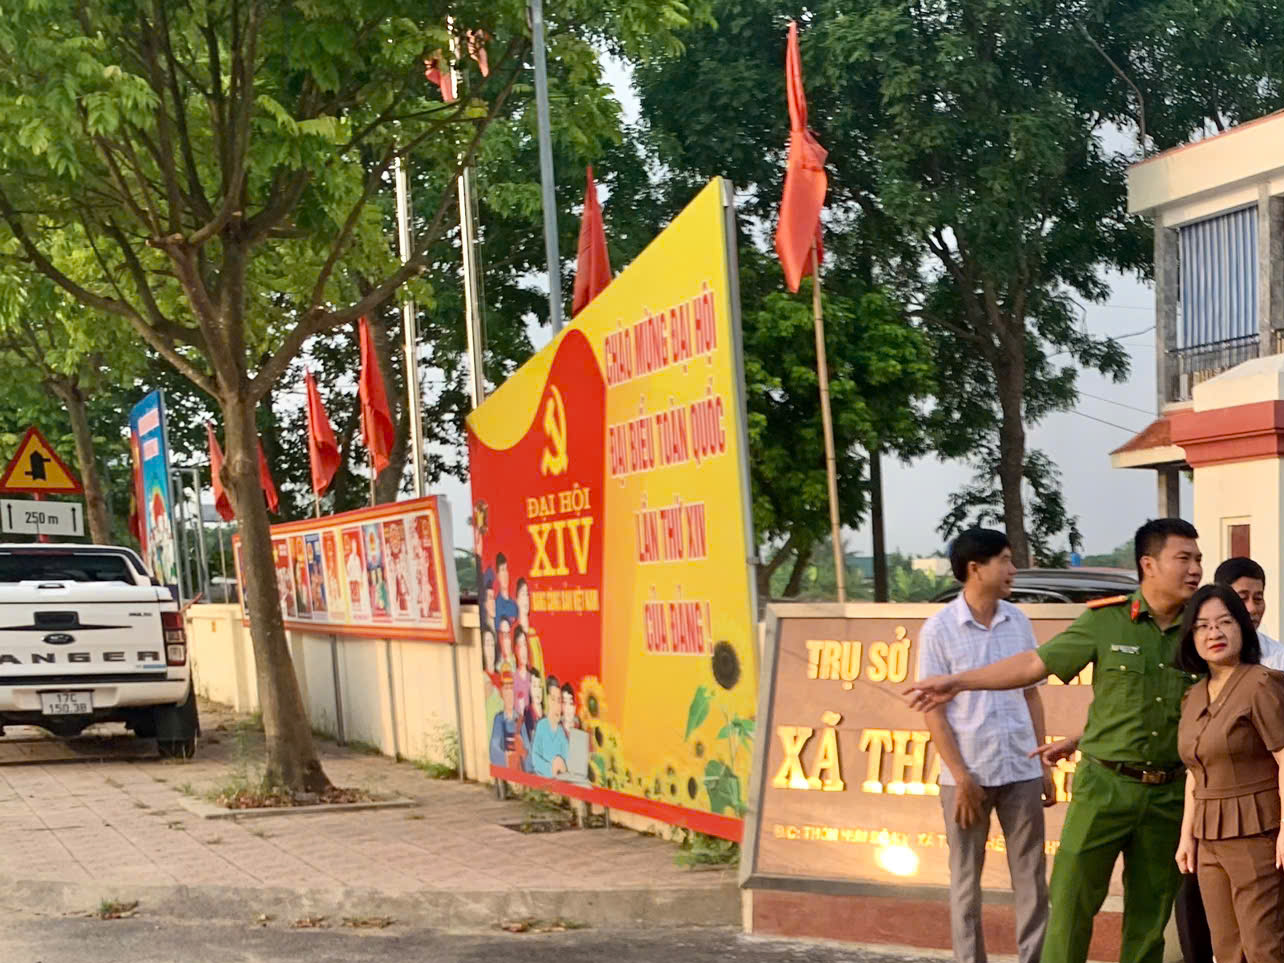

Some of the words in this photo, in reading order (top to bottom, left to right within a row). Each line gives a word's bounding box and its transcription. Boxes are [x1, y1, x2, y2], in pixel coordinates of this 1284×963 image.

[605, 318, 633, 388] CHÀO
[634, 306, 670, 378] MỪNG
[670, 303, 693, 375] ĐẠI
[693, 281, 718, 365] HỘI
[608, 423, 629, 488] ĐẠI
[629, 393, 655, 472] BIỂU
[655, 396, 690, 467] TOÀN
[690, 375, 726, 468] QUỐC
[25, 511, 46, 525] 250
[47, 514, 59, 525] m
[526, 493, 556, 521] ĐẠI
[558, 482, 592, 517] HỘI
[635, 492, 661, 566] LẦN
[660, 492, 685, 564] THỨ
[684, 502, 708, 562] XIV
[527, 516, 594, 578] XIV
[644, 584, 669, 653] CỦA
[669, 584, 706, 655] ĐẢNG
[0, 650, 160, 665] ANGER
[804, 639, 862, 691] TRỤ
[866, 625, 911, 683] SỞ
